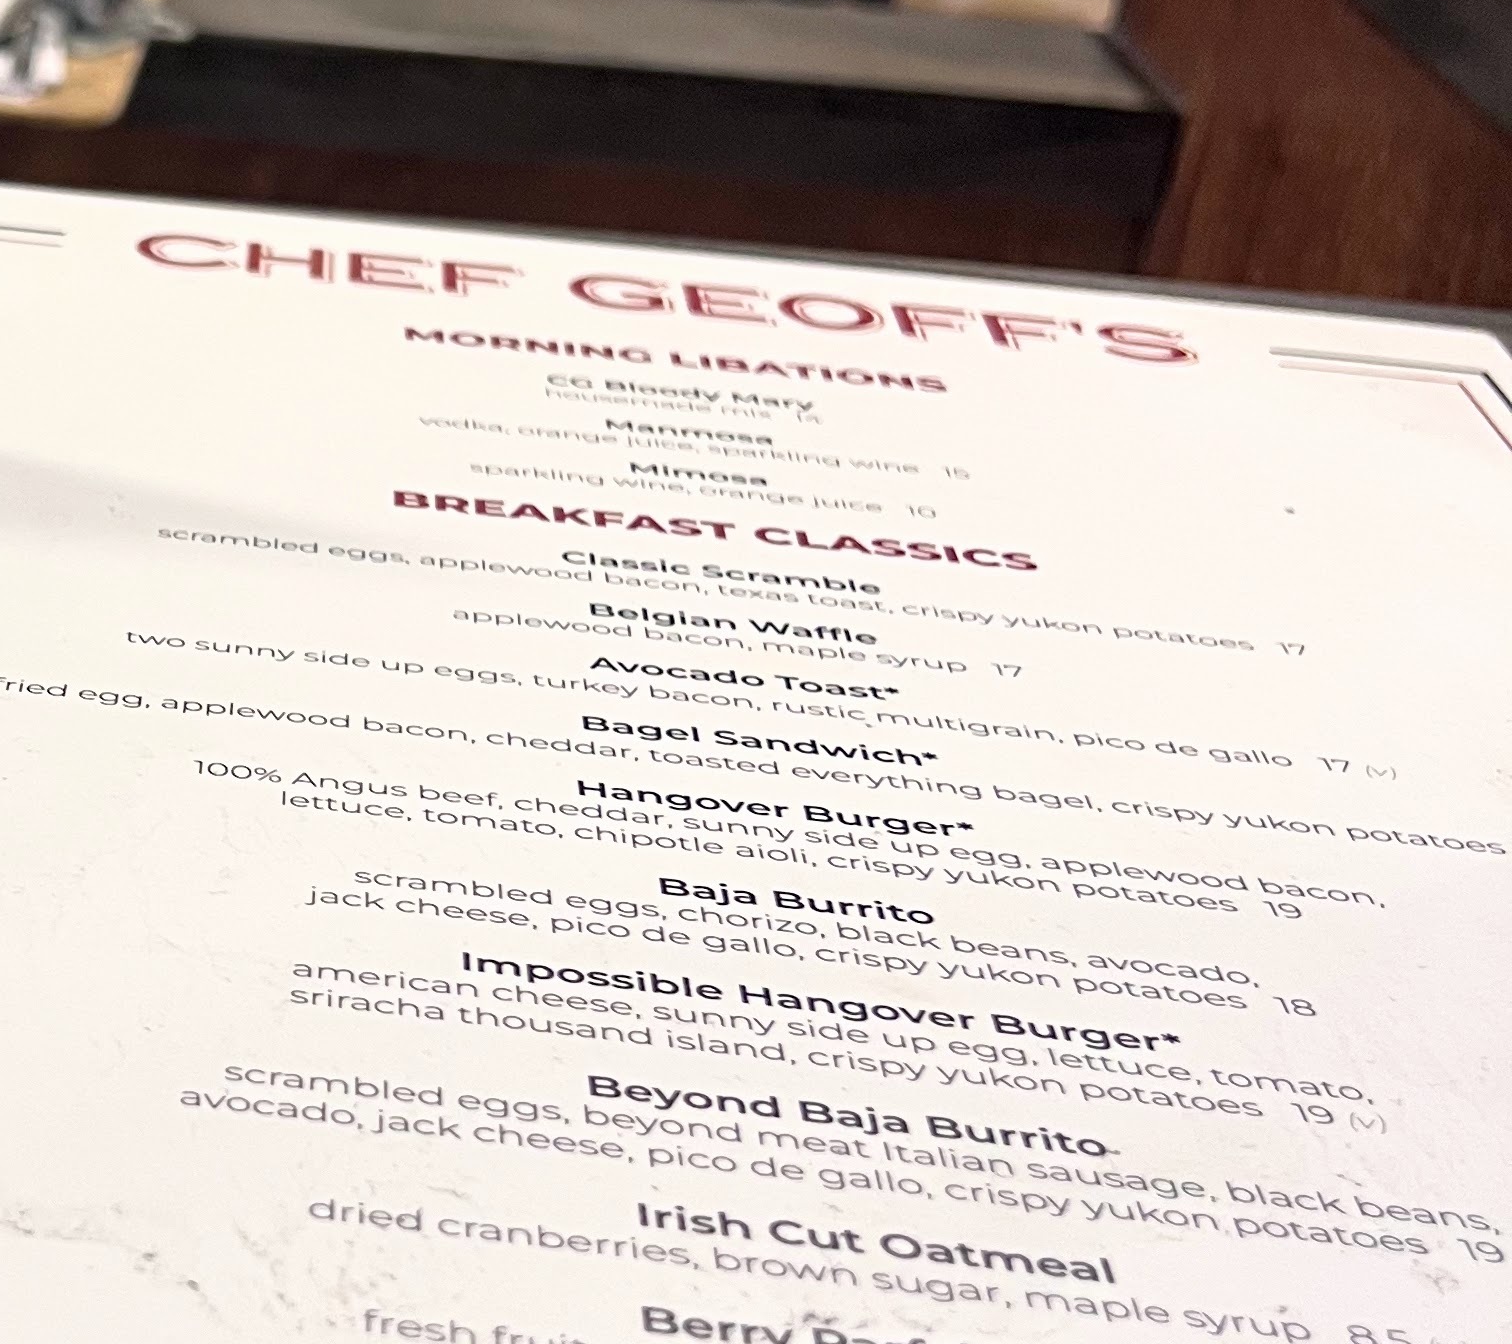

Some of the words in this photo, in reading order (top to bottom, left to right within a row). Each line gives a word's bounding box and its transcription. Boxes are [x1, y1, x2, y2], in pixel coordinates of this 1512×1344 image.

[135, 233, 516, 297] CHEF
[404, 326, 652, 364] MORNING
[669, 351, 948, 393] LIBATIONS
[393, 490, 736, 541] BREAKFAST
[754, 527, 1038, 571] CLASSICS
[561, 551, 690, 576] Classic
[702, 564, 881, 594] Scramble
[589, 603, 737, 631] Belgian
[748, 619, 877, 645] Waffle
[126, 631, 186, 648] two
[194, 640, 296, 662] sunny
[303, 650, 371, 668] side
[381, 659, 424, 676] up
[434, 665, 522, 687] eggs,
[532, 674, 639, 699] turkey
[649, 684, 762, 712] bacon,
[770, 700, 868, 720] rustic
[875, 710, 1065, 745] multigrain,
[1072, 732, 1146, 752] pico
[1154, 740, 1200, 758] de
[1208, 747, 1294, 768] gallo
[1316, 756, 1351, 773] 17
[589, 657, 765, 687] Avocado
[581, 715, 700, 743] Bagel
[577, 779, 789, 818] Hangover
[281, 790, 412, 822] lettuce,
[422, 808, 564, 839] tomato,
[574, 825, 724, 855] chipotle
[736, 843, 817, 868] aioli,
[827, 855, 935, 882] crispy
[942, 868, 1062, 893] yukon
[1072, 883, 1239, 913] potatoes
[1262, 900, 1303, 919] 19
[354, 871, 553, 906] scrambled
[565, 895, 667, 921] eggs,
[677, 906, 826, 940] chorizo,
[836, 921, 942, 950] black
[950, 934, 1078, 969] beans,
[1087, 954, 1260, 989] avocado,
[658, 877, 758, 906] Baja
[772, 890, 935, 925] Burrito
[462, 951, 723, 1001] Impossible
[738, 984, 975, 1030] Hangover
[587, 1075, 782, 1119] Beyond
[798, 1100, 910, 1136] Baja
[925, 1115, 1109, 1158] Burrito
[307, 1198, 424, 1233] dried
[437, 1218, 700, 1271] cranberries,
[712, 1246, 858, 1287] brown
[871, 1271, 1014, 1310] sugar,
[1024, 1290, 1171, 1325] maple
[637, 1202, 753, 1241] Irish
[768, 1219, 866, 1254] Cut
[879, 1233, 1116, 1284] Oatmeal
